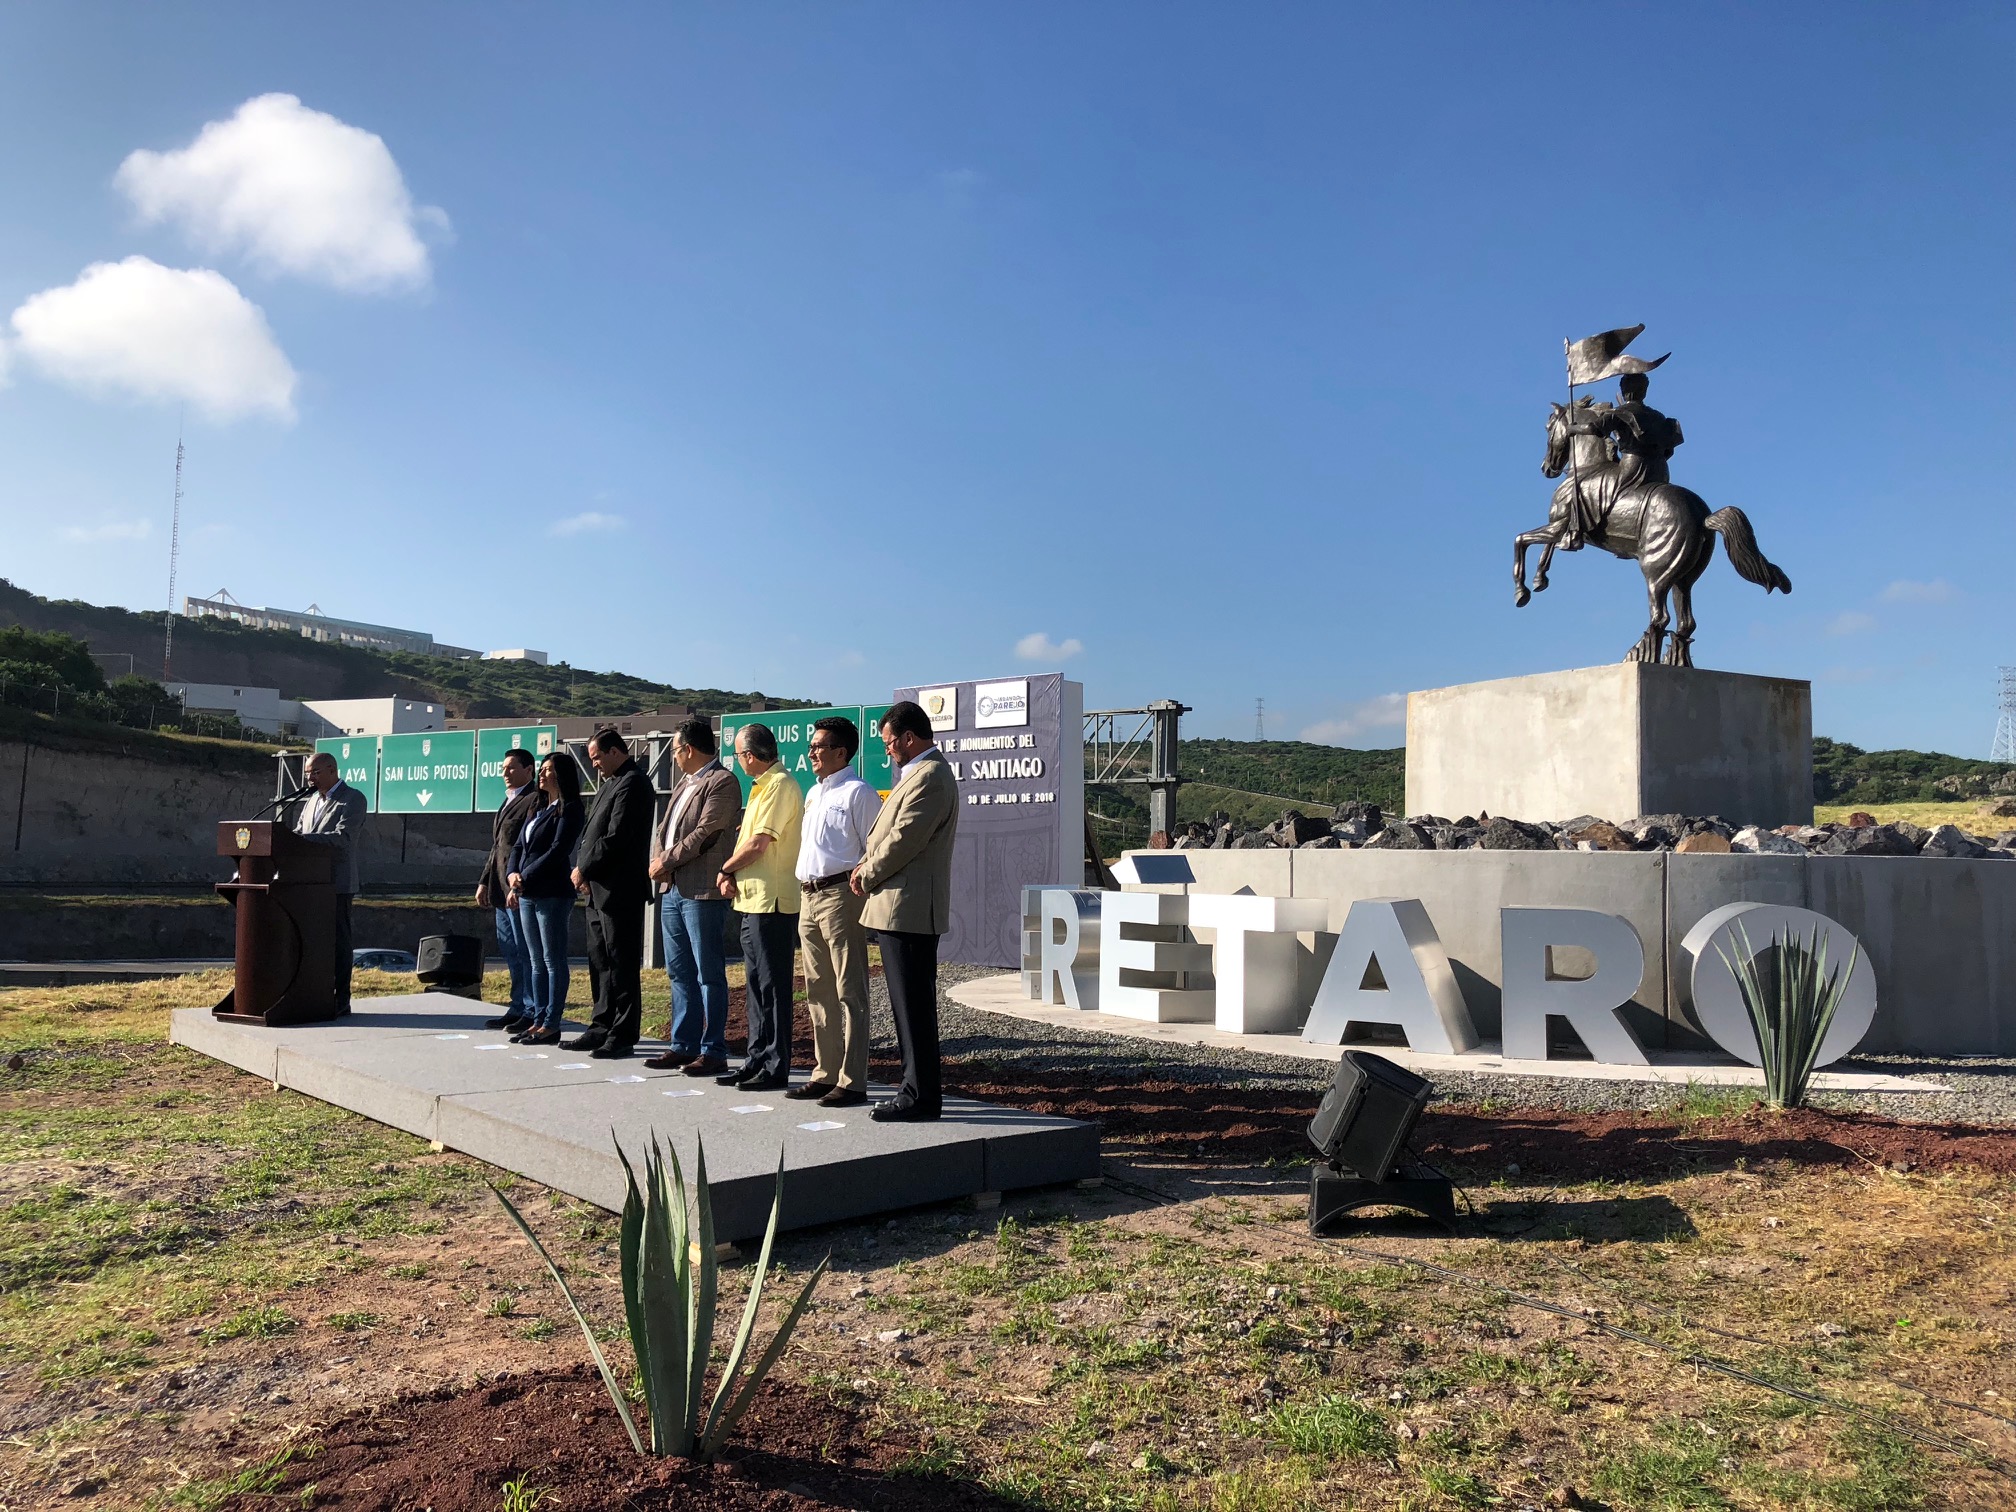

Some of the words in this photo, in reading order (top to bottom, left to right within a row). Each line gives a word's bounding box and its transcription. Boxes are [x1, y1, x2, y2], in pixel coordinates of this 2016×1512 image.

[993, 701, 1025, 710] PAREJO
[946, 739, 956, 752] DE
[960, 736, 1015, 750] MONUMENTOS
[1019, 734, 1035, 747] DEL
[385, 767, 403, 781] SAN
[408, 766, 428, 780] LUIS
[434, 765, 468, 779] POTOSI
[971, 758, 1042, 779] SANTIAGO
[968, 795, 977, 804] 30
[981, 795, 990, 804] DE
[995, 794, 1017, 803] JULIO
[1022, 793, 1031, 802] DE
[1035, 792, 1054, 802] 2018
